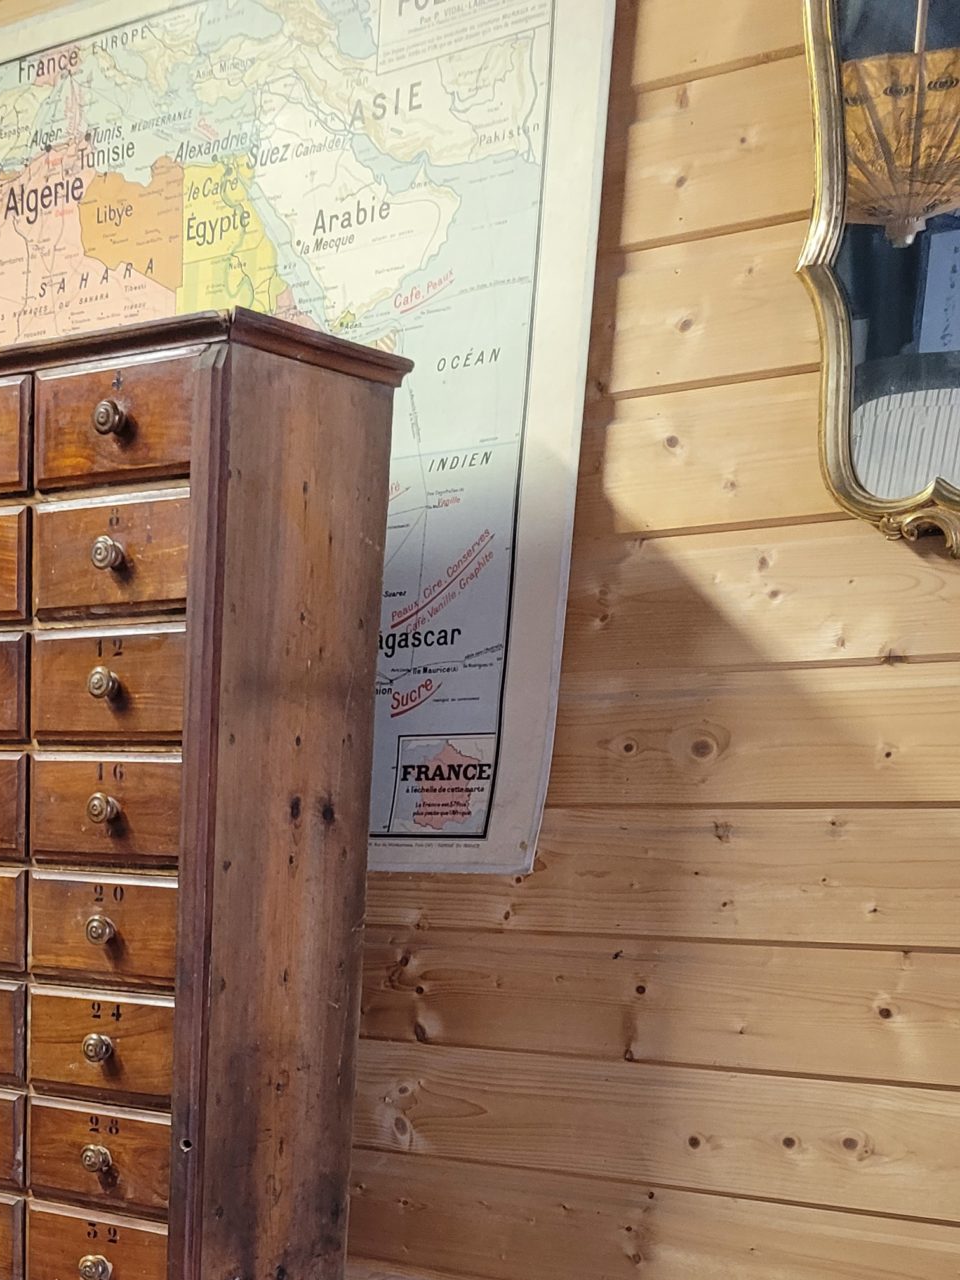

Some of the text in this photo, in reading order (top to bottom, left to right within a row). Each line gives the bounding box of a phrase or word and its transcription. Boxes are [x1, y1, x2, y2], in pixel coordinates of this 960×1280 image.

[92, 27, 147, 55] EUROPE
[19, 50, 78, 83] France
[348, 81, 422, 129] ASIE
[30, 127, 62, 150] Alger
[92, 124, 122, 145] Tunis
[175, 130, 248, 162] Alexandrie
[479, 122, 540, 146] Pakistan
[78, 138, 135, 170] Tunisie
[246, 143, 290, 169] Suez
[187, 181, 200, 202] le
[96, 203, 133, 227] Libye
[312, 196, 391, 236] Arabie
[186, 210, 251, 247] Égypte
[300, 241, 309, 256] la
[312, 234, 355, 253] Mecque
[437, 347, 501, 372] OCÉAN
[111, 370, 123, 390] 4
[428, 451, 492, 473] INDIEN
[446, 528, 491, 578] Conserves
[459, 551, 494, 590] Graphite
[95, 639, 123, 657] 12
[391, 678, 433, 709] Sucre
[97, 762, 123, 782] 16
[400, 764, 491, 781] FRANCE
[93, 885, 124, 902] 20
[91, 1002, 122, 1022] 24
[89, 1115, 120, 1135] 28
[86, 1222, 118, 1244] 32
